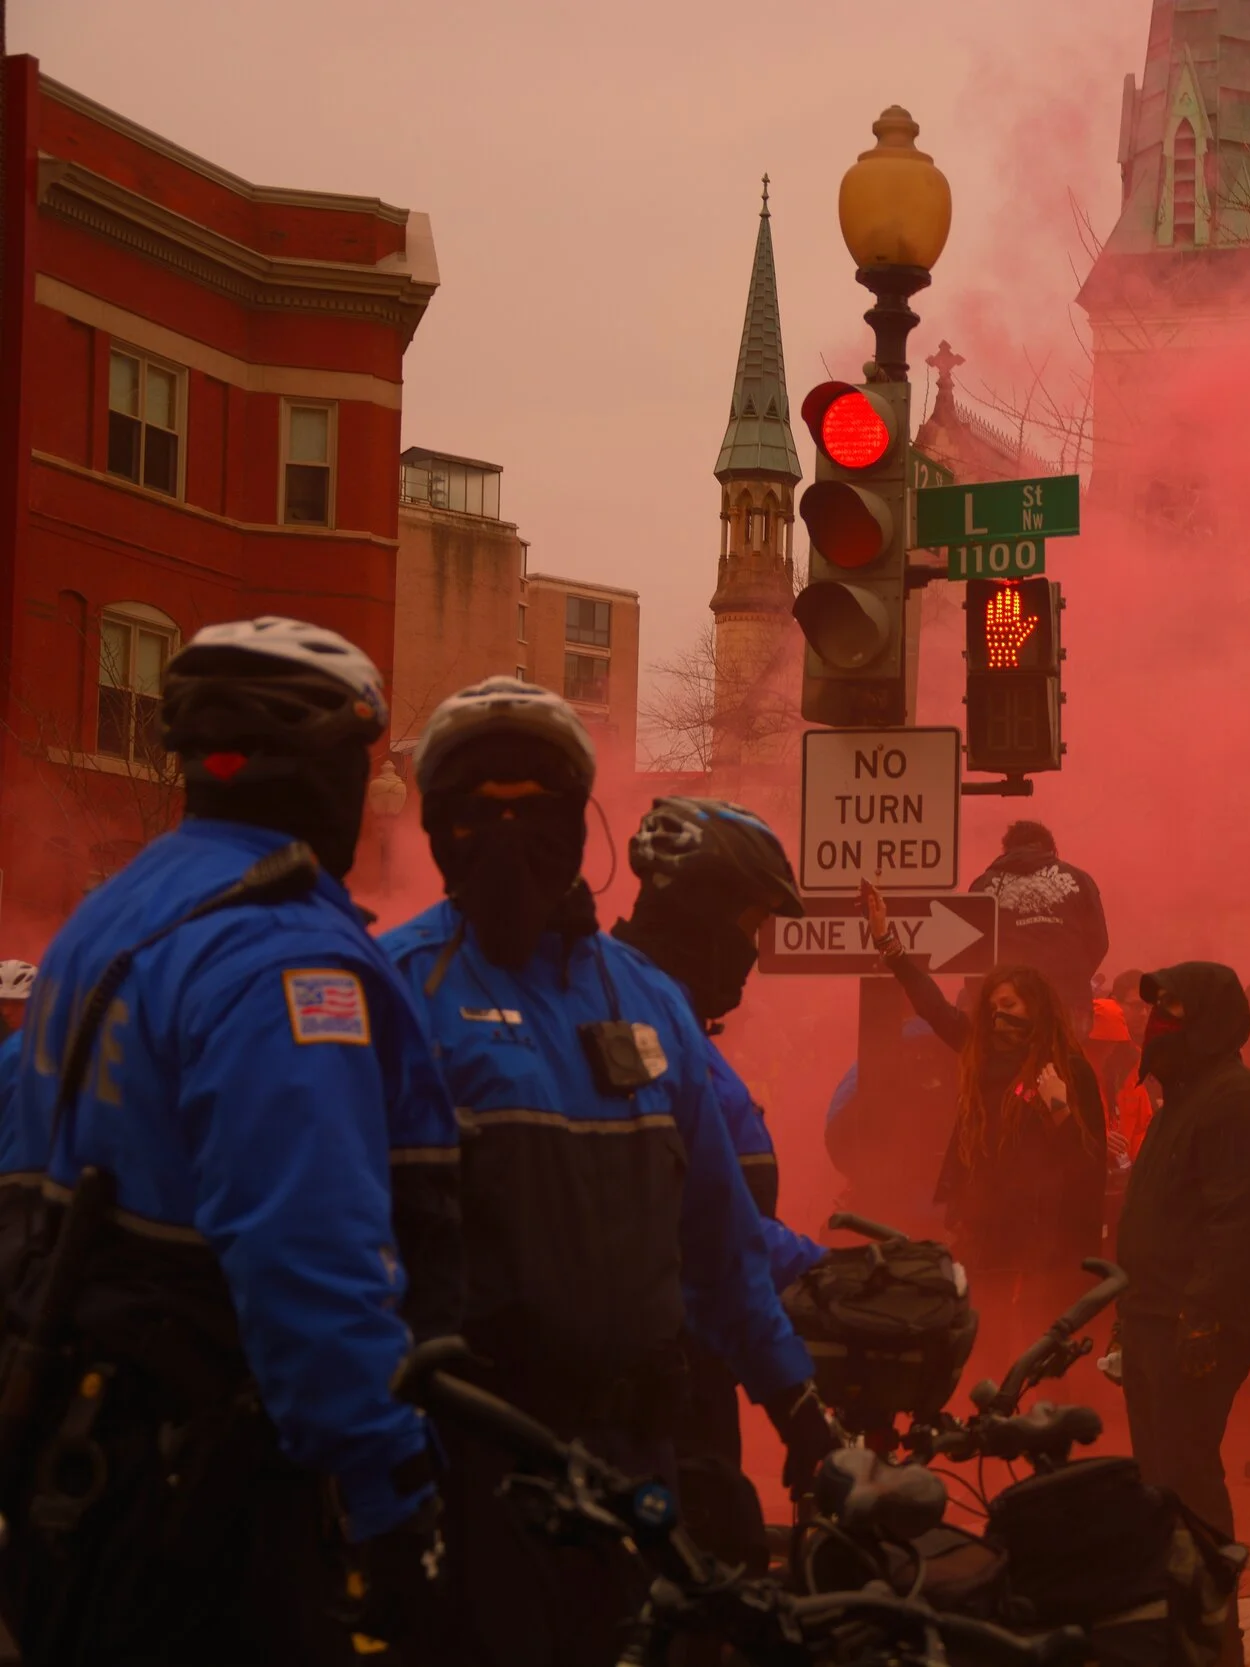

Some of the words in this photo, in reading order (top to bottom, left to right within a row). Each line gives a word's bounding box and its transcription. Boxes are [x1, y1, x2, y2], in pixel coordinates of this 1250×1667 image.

[964, 493, 988, 536] L
[1023, 485, 1043, 507] St
[957, 540, 1037, 575] 1100
[854, 749, 907, 780] NO
[835, 794, 923, 825] TURN
[817, 840, 862, 871] ON
[876, 839, 941, 870] RED
[782, 920, 846, 951] ONE
